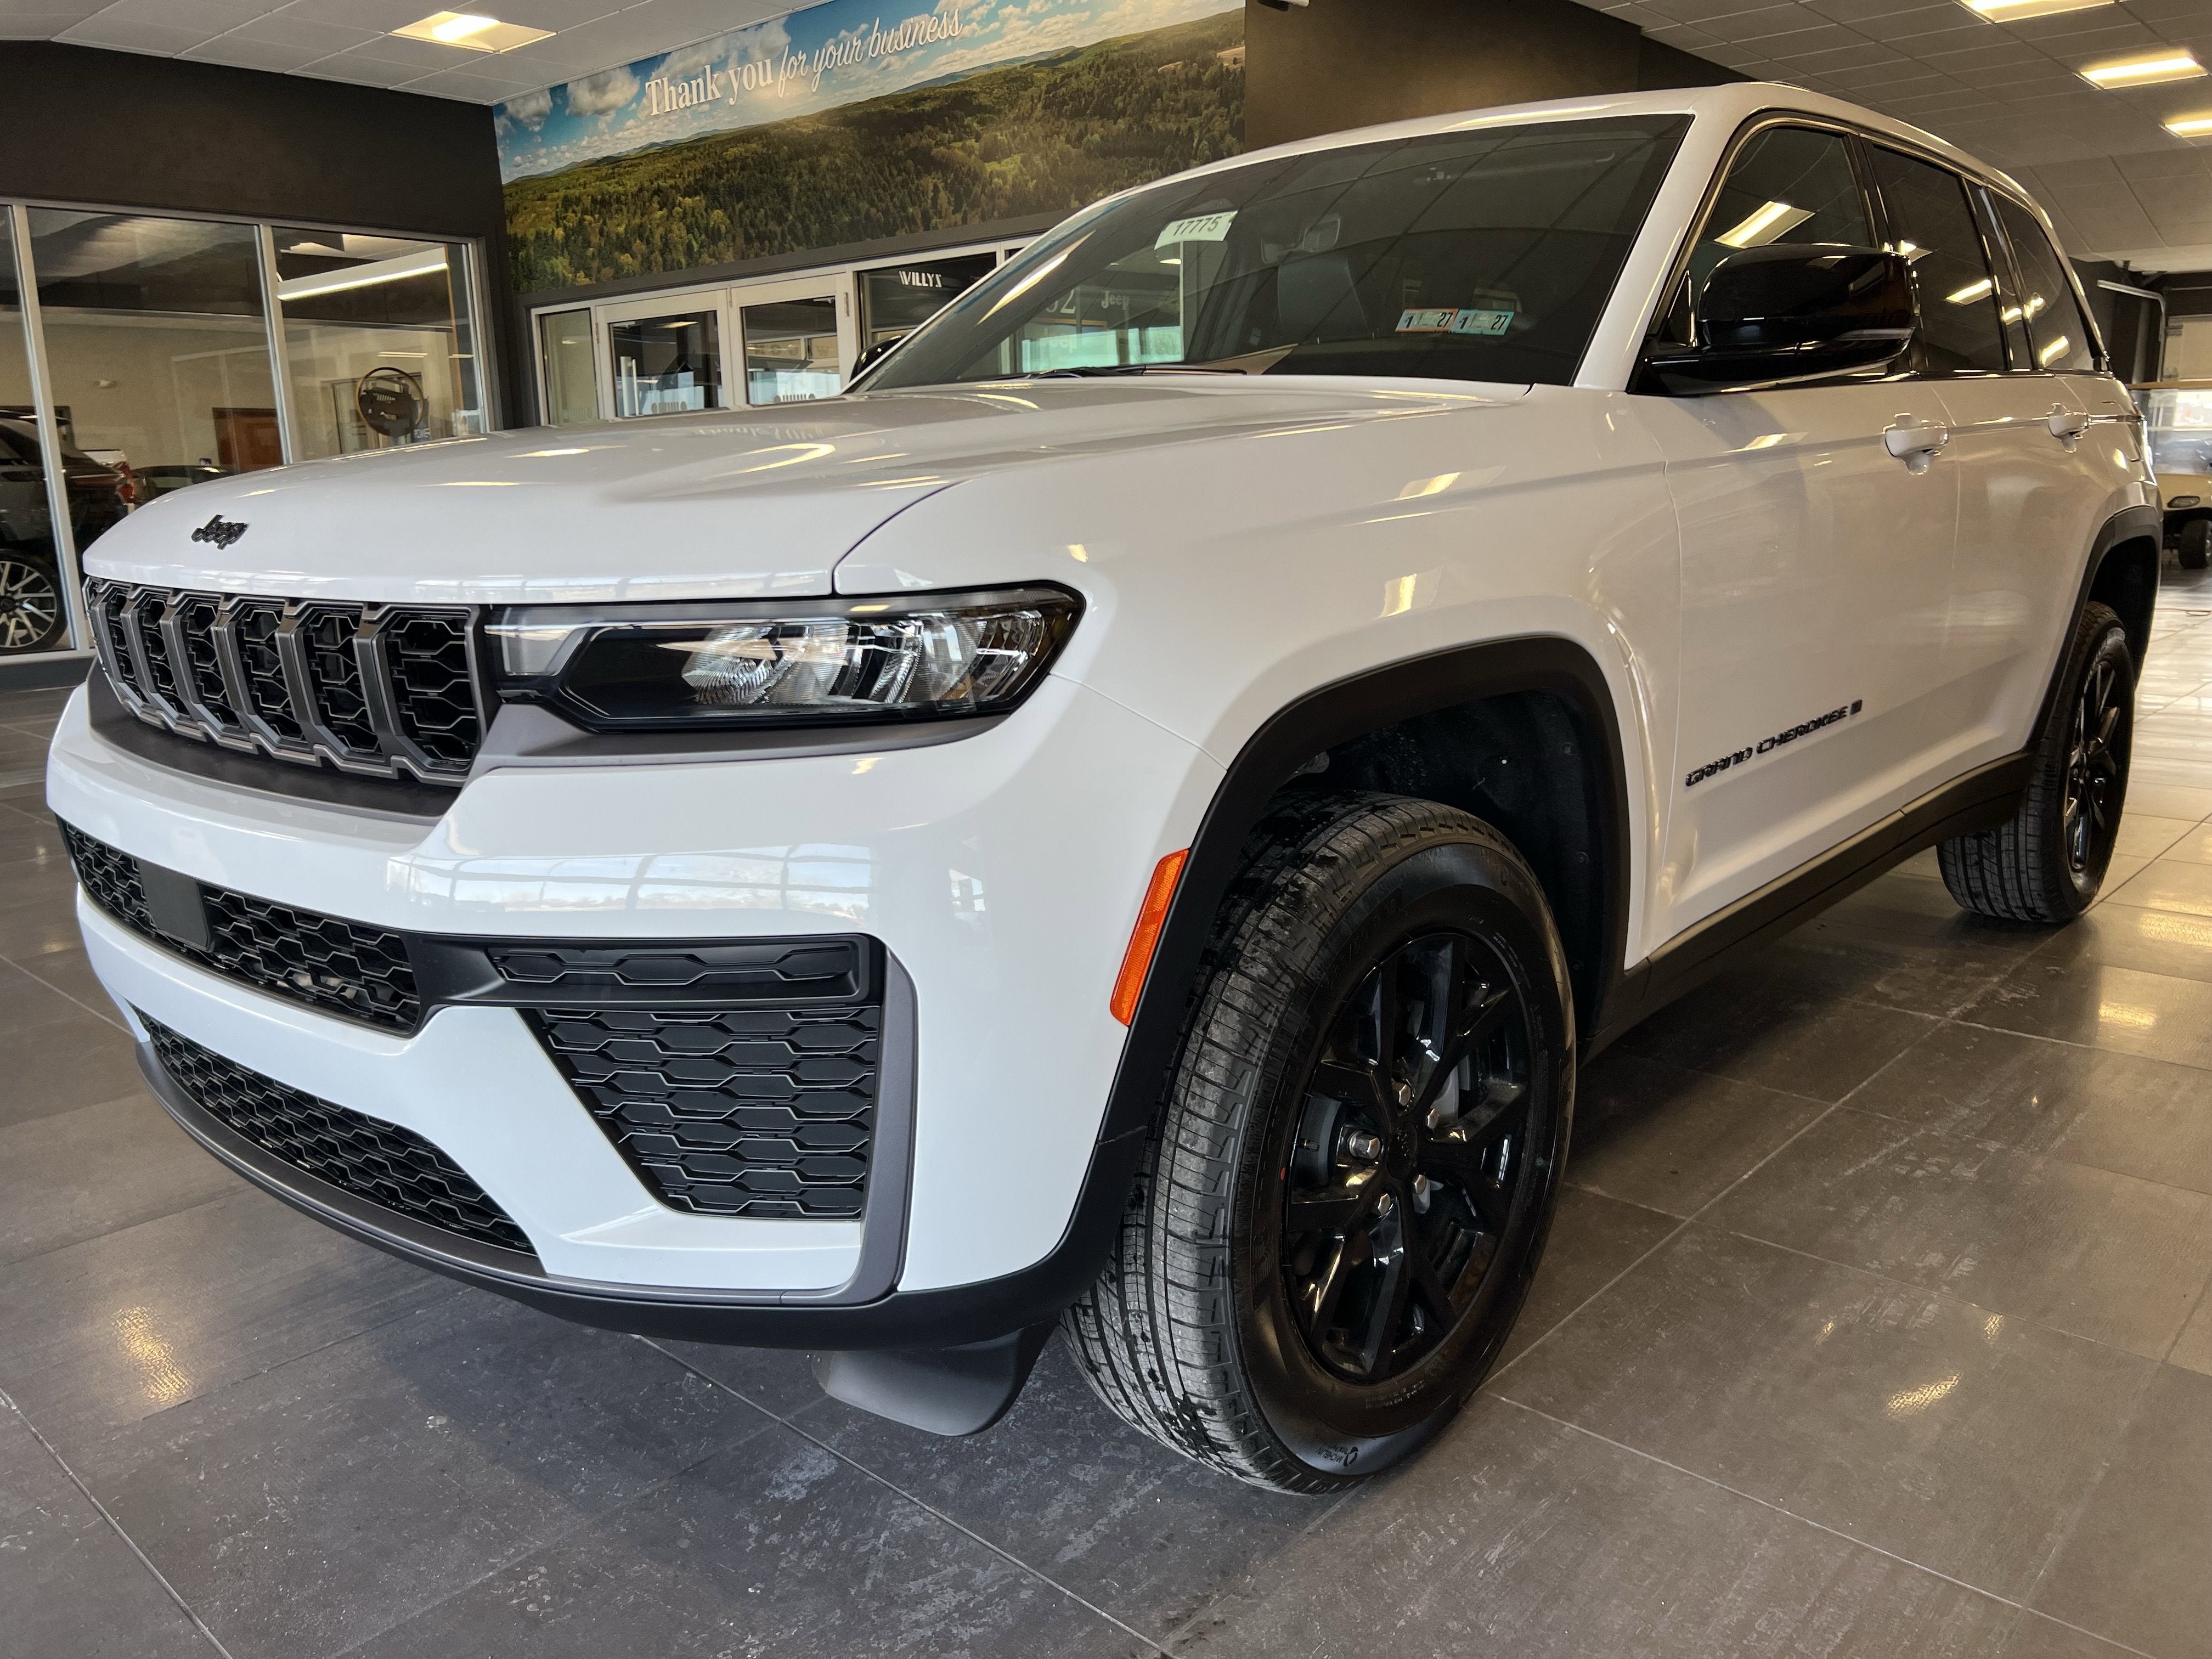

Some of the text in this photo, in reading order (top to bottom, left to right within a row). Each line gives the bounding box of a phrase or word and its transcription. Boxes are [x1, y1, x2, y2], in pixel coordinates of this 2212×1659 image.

[645, 8, 963, 116] Thank you for your business
[1173, 216, 1223, 236] 17775
[899, 270, 943, 288] WILLYS
[1101, 290, 1130, 310] Jeep
[1436, 312, 1453, 328] 27
[1491, 314, 1509, 331] 27
[191, 515, 249, 550] Jeep
[1685, 706, 1848, 787] GRAND CHEROKEE
